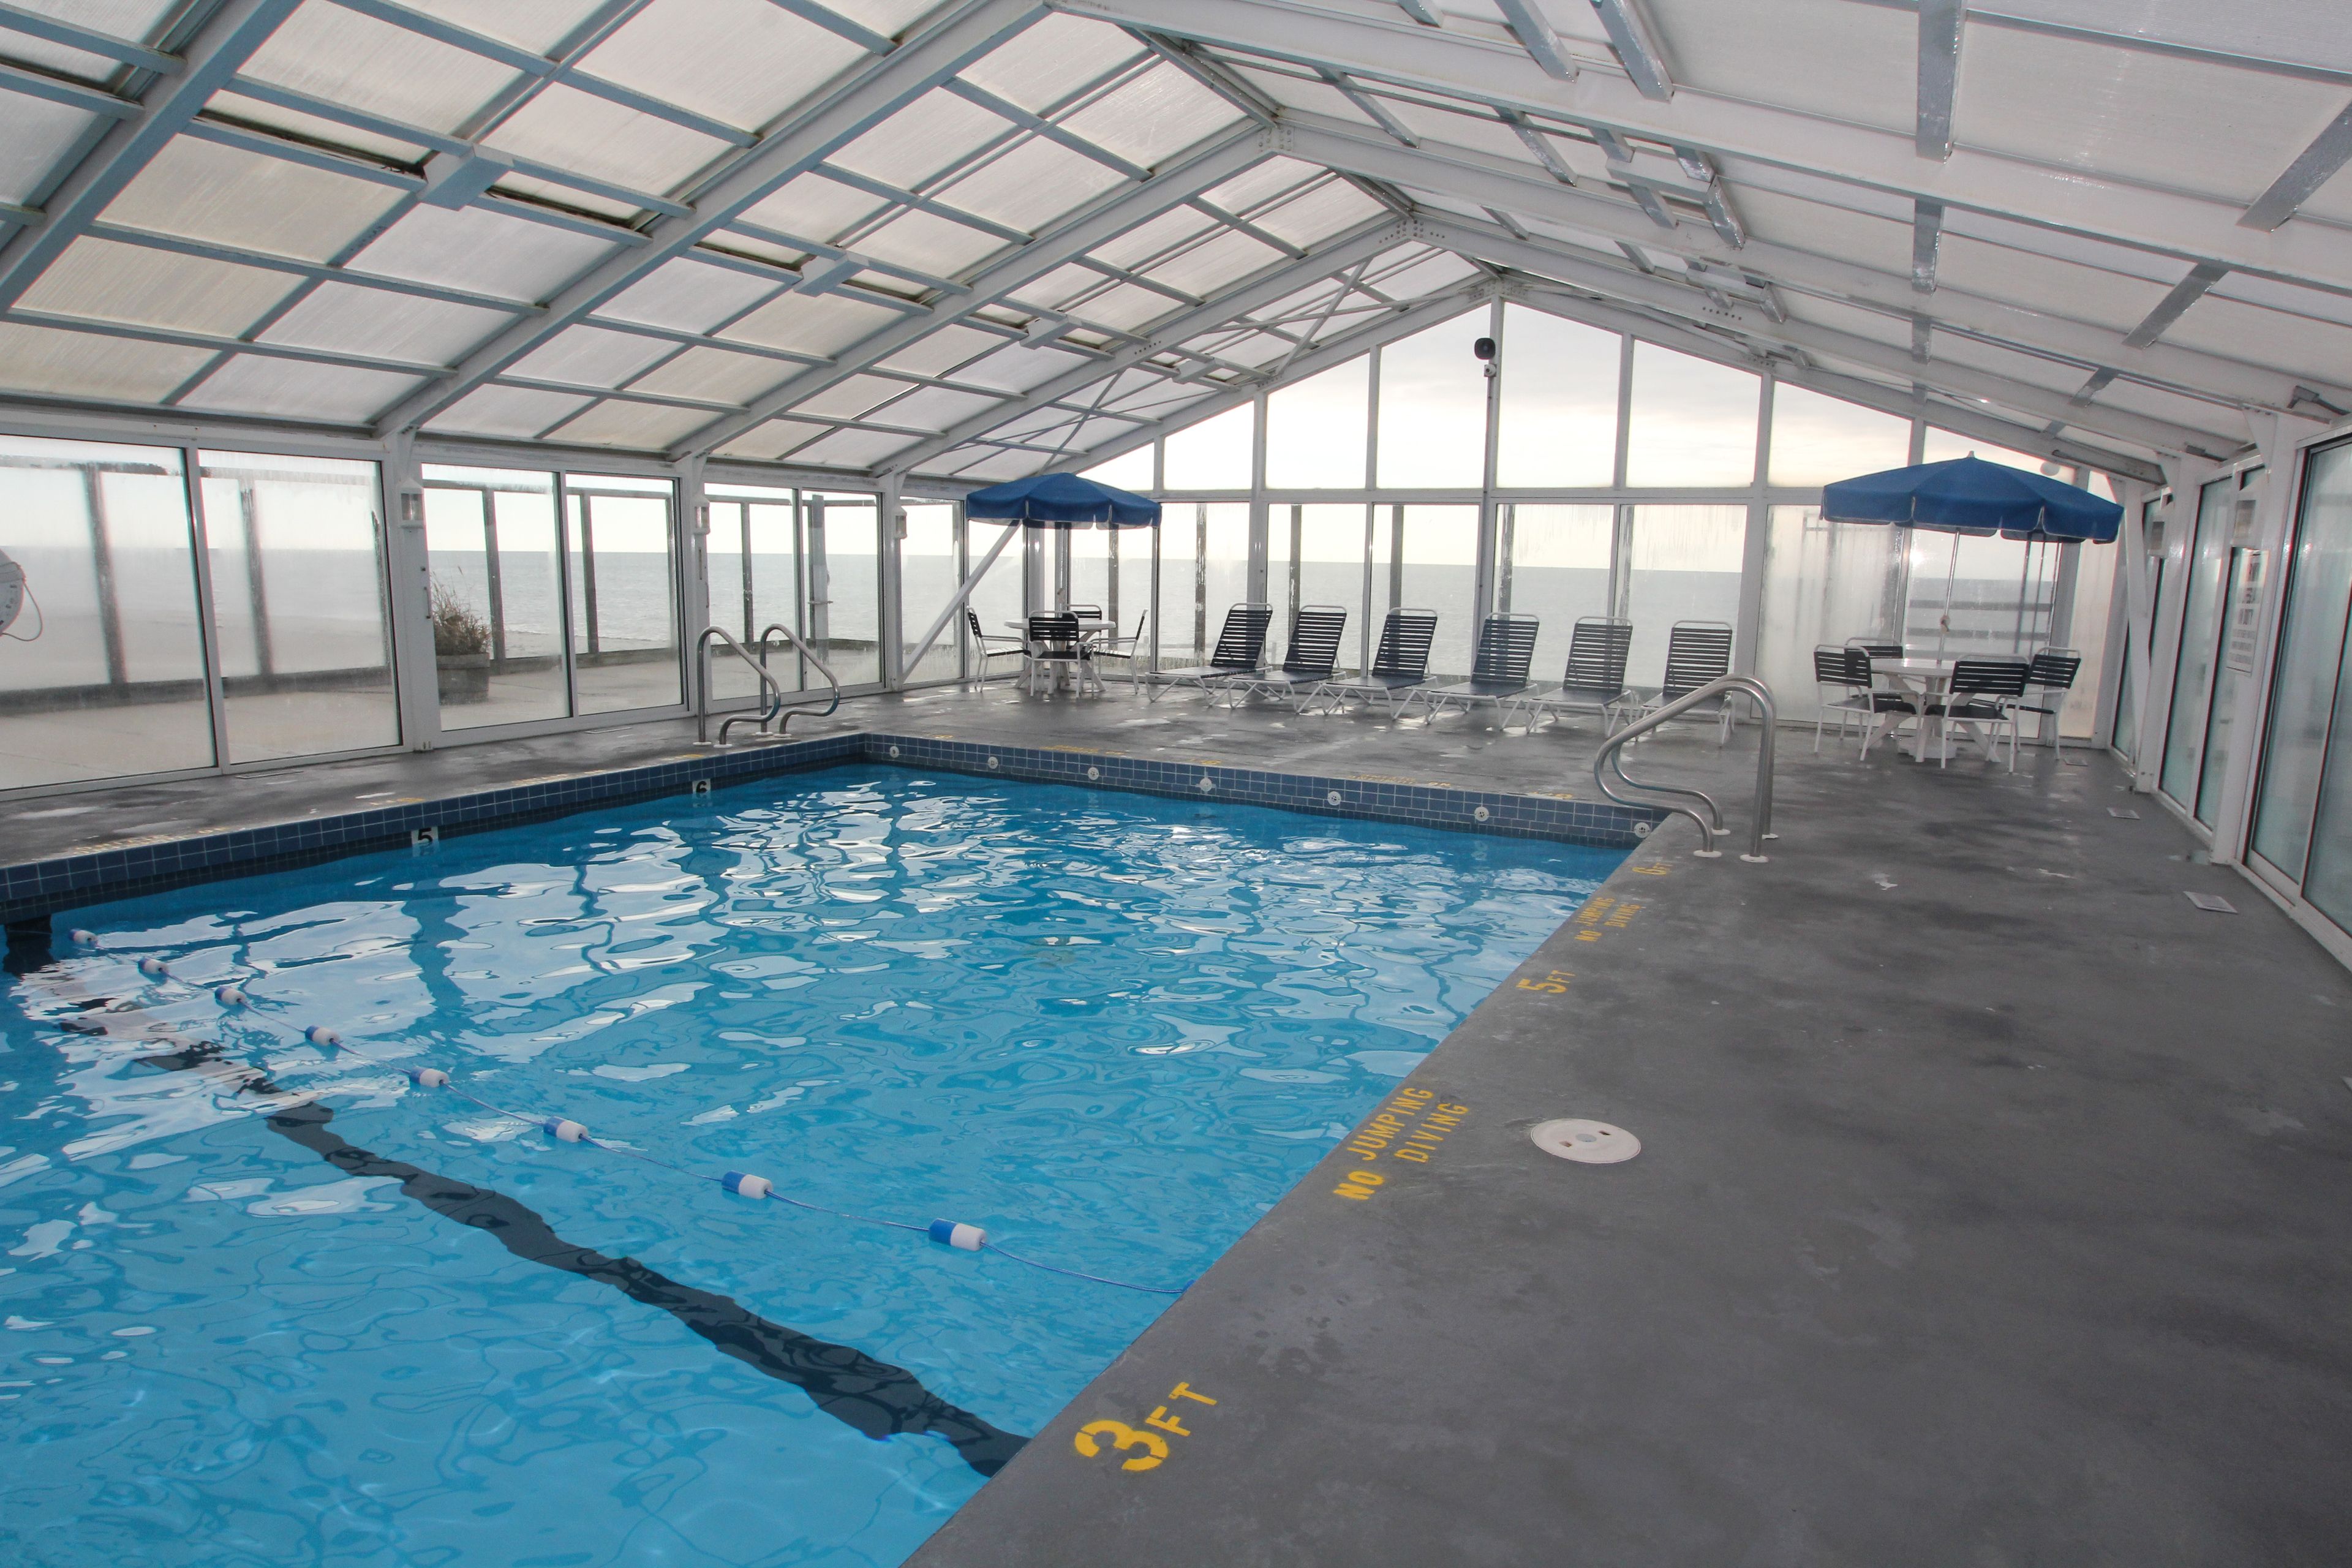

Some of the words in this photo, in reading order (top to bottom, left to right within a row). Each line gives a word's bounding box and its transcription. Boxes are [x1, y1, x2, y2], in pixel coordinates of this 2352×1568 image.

[696, 781, 707, 794] 6
[418, 827, 433, 845] 5
[1575, 897, 1615, 927] JUMPING
[1604, 904, 1641, 927] DIVING
[1574, 930, 1602, 941] NO
[1516, 979, 1568, 993] 5
[1348, 1088, 1434, 1161] JUMPING
[1394, 1103, 1469, 1163] DIVING
[1333, 1170, 1384, 1200] NO
[1075, 1420, 1169, 1471] 3
[1145, 1382, 1218, 1436] FT
